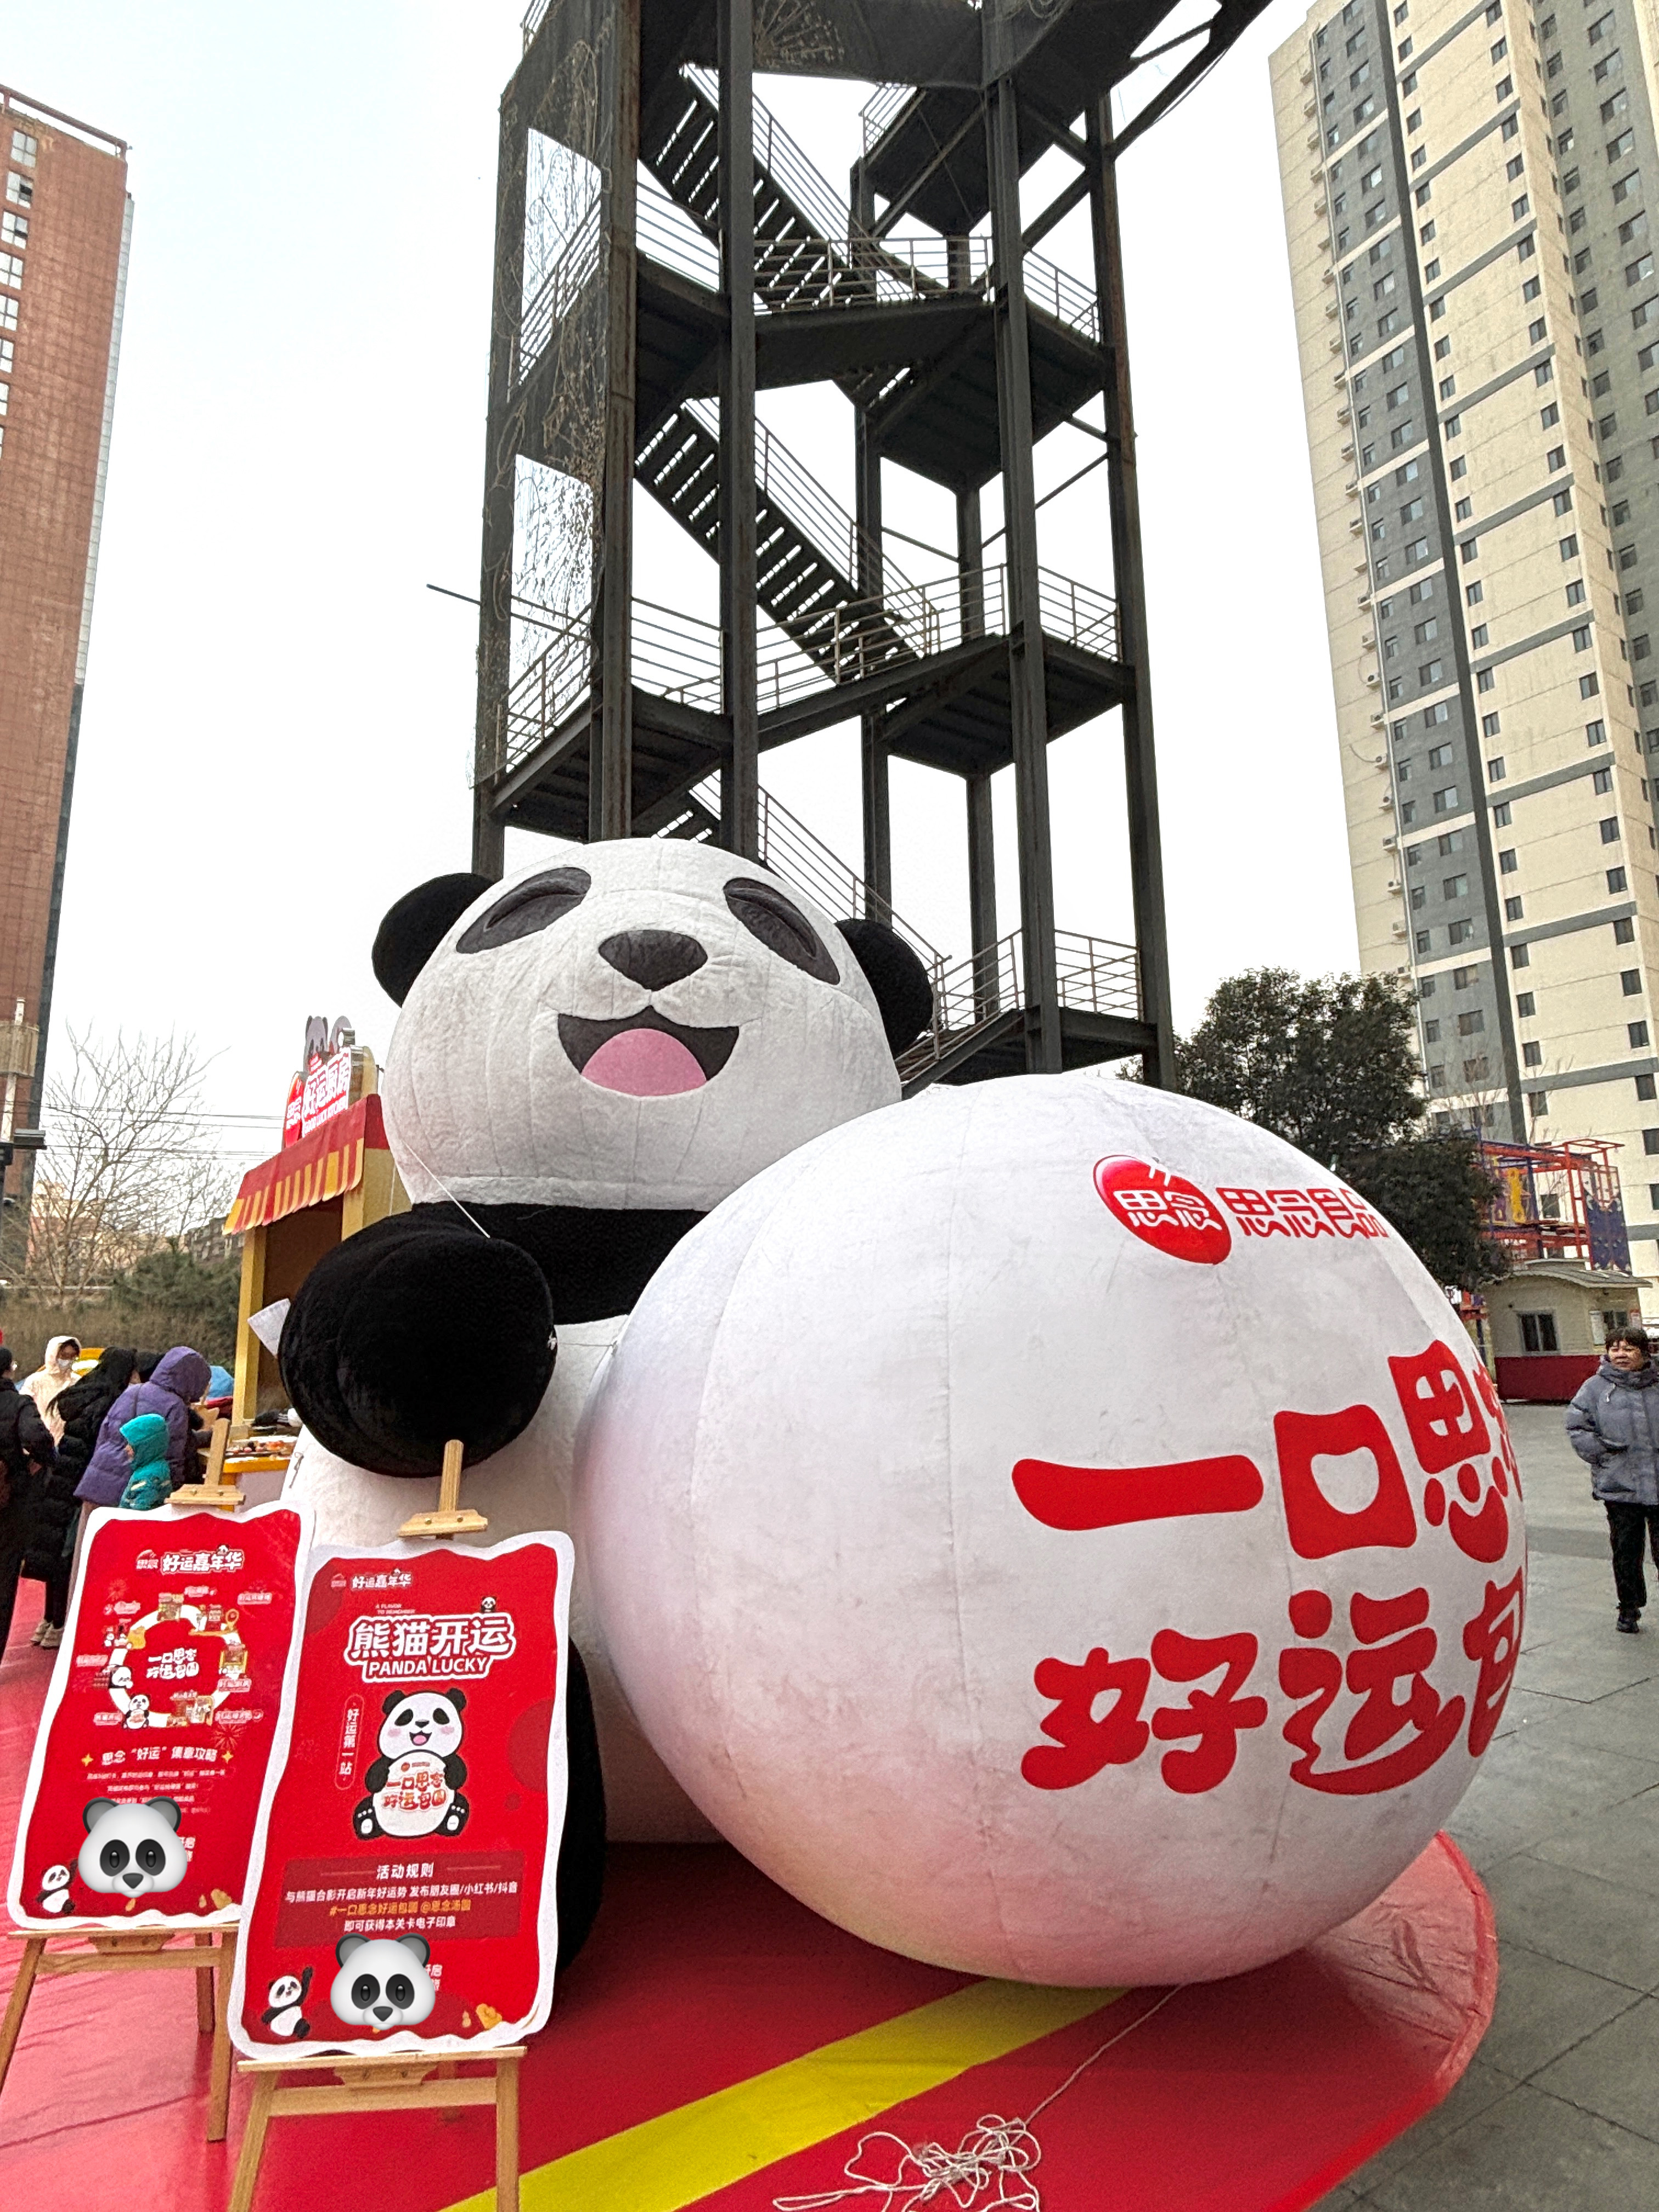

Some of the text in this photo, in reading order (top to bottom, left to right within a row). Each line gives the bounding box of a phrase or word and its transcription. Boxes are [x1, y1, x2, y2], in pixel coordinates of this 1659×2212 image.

[1113, 1187, 1389, 1239] 思念 思念食品
[163, 1551, 242, 1572] 好运嘉年华
[352, 1573, 412, 1589] 好运嘉年华
[352, 1618, 510, 1660] 熊猫开运
[369, 1657, 487, 1676] PANDA LUCKY
[338, 1708, 359, 1775] 好运第一站
[101, 1750, 126, 1766] 思念
[376, 1863, 434, 1880] 活动规则
[343, 1916, 456, 1932] 即可获得本关卡电子印章
